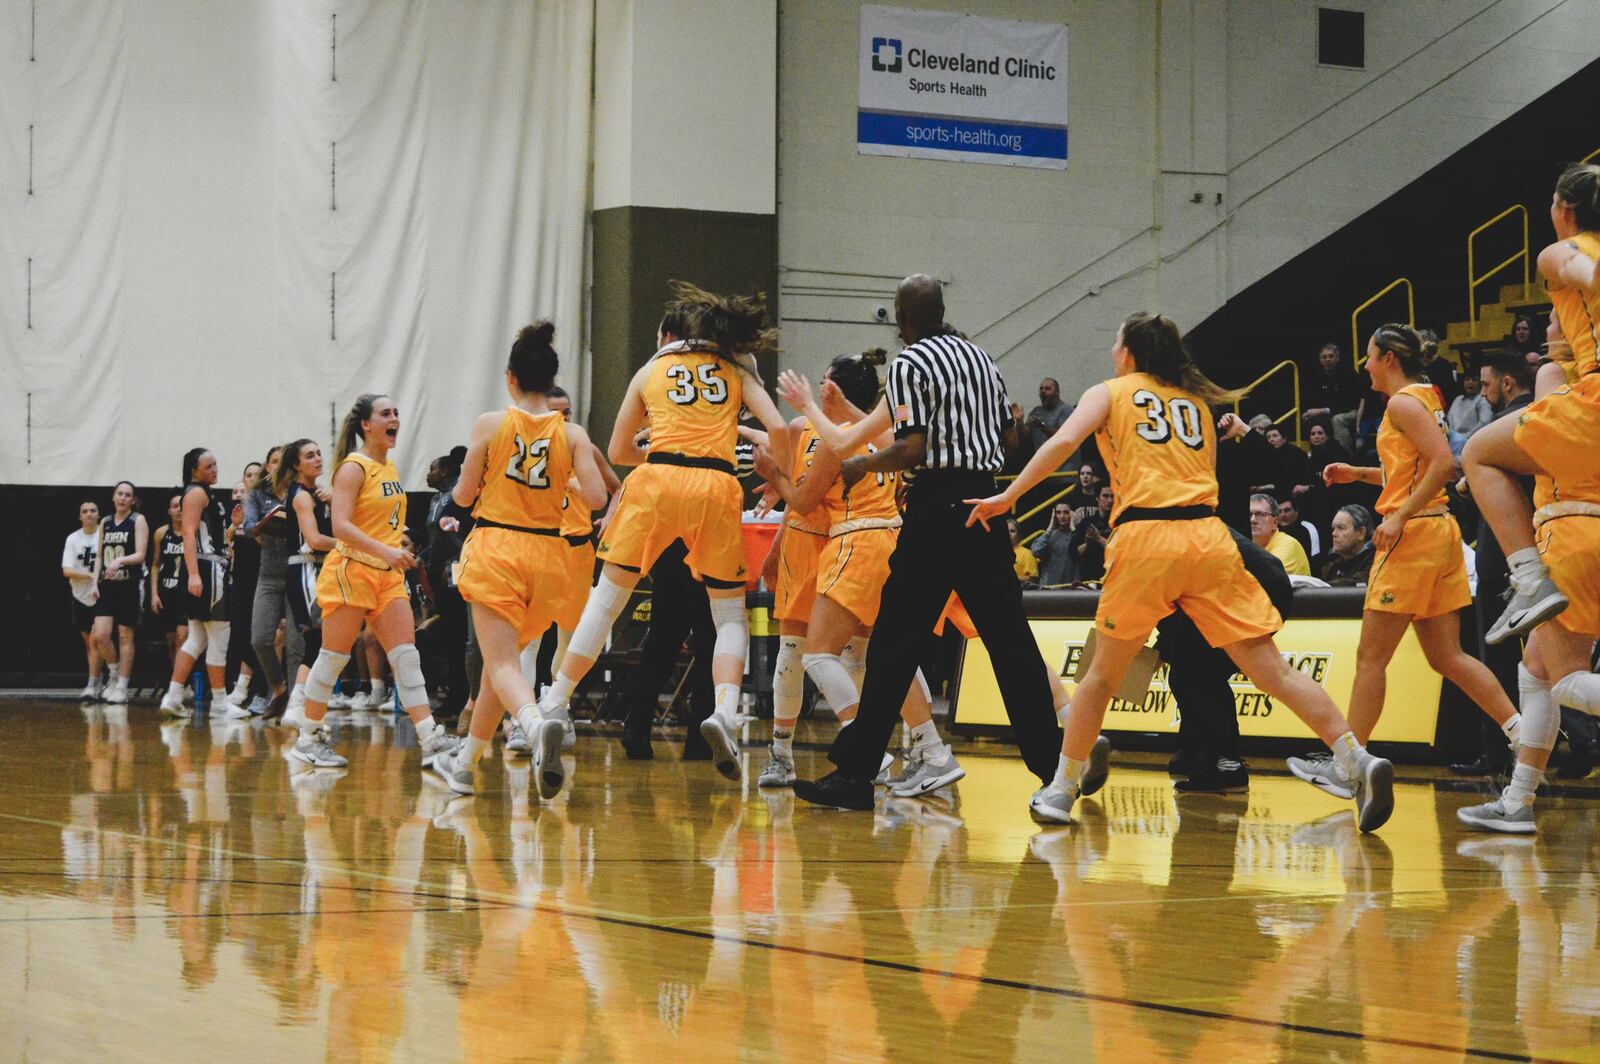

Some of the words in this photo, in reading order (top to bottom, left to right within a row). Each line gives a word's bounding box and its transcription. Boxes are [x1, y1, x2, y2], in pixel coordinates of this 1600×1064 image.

[908, 48, 999, 76] Cleveland
[1005, 57, 1056, 81] Clinic
[909, 78, 946, 94] Sports
[950, 82, 987, 97] Health
[906, 125, 1022, 152] sports-health.org
[667, 363, 728, 405] 35
[1133, 389, 1204, 451] 30
[505, 434, 552, 489] 22
[389, 501, 401, 530] 4
[1110, 690, 1172, 713] ELLOW
